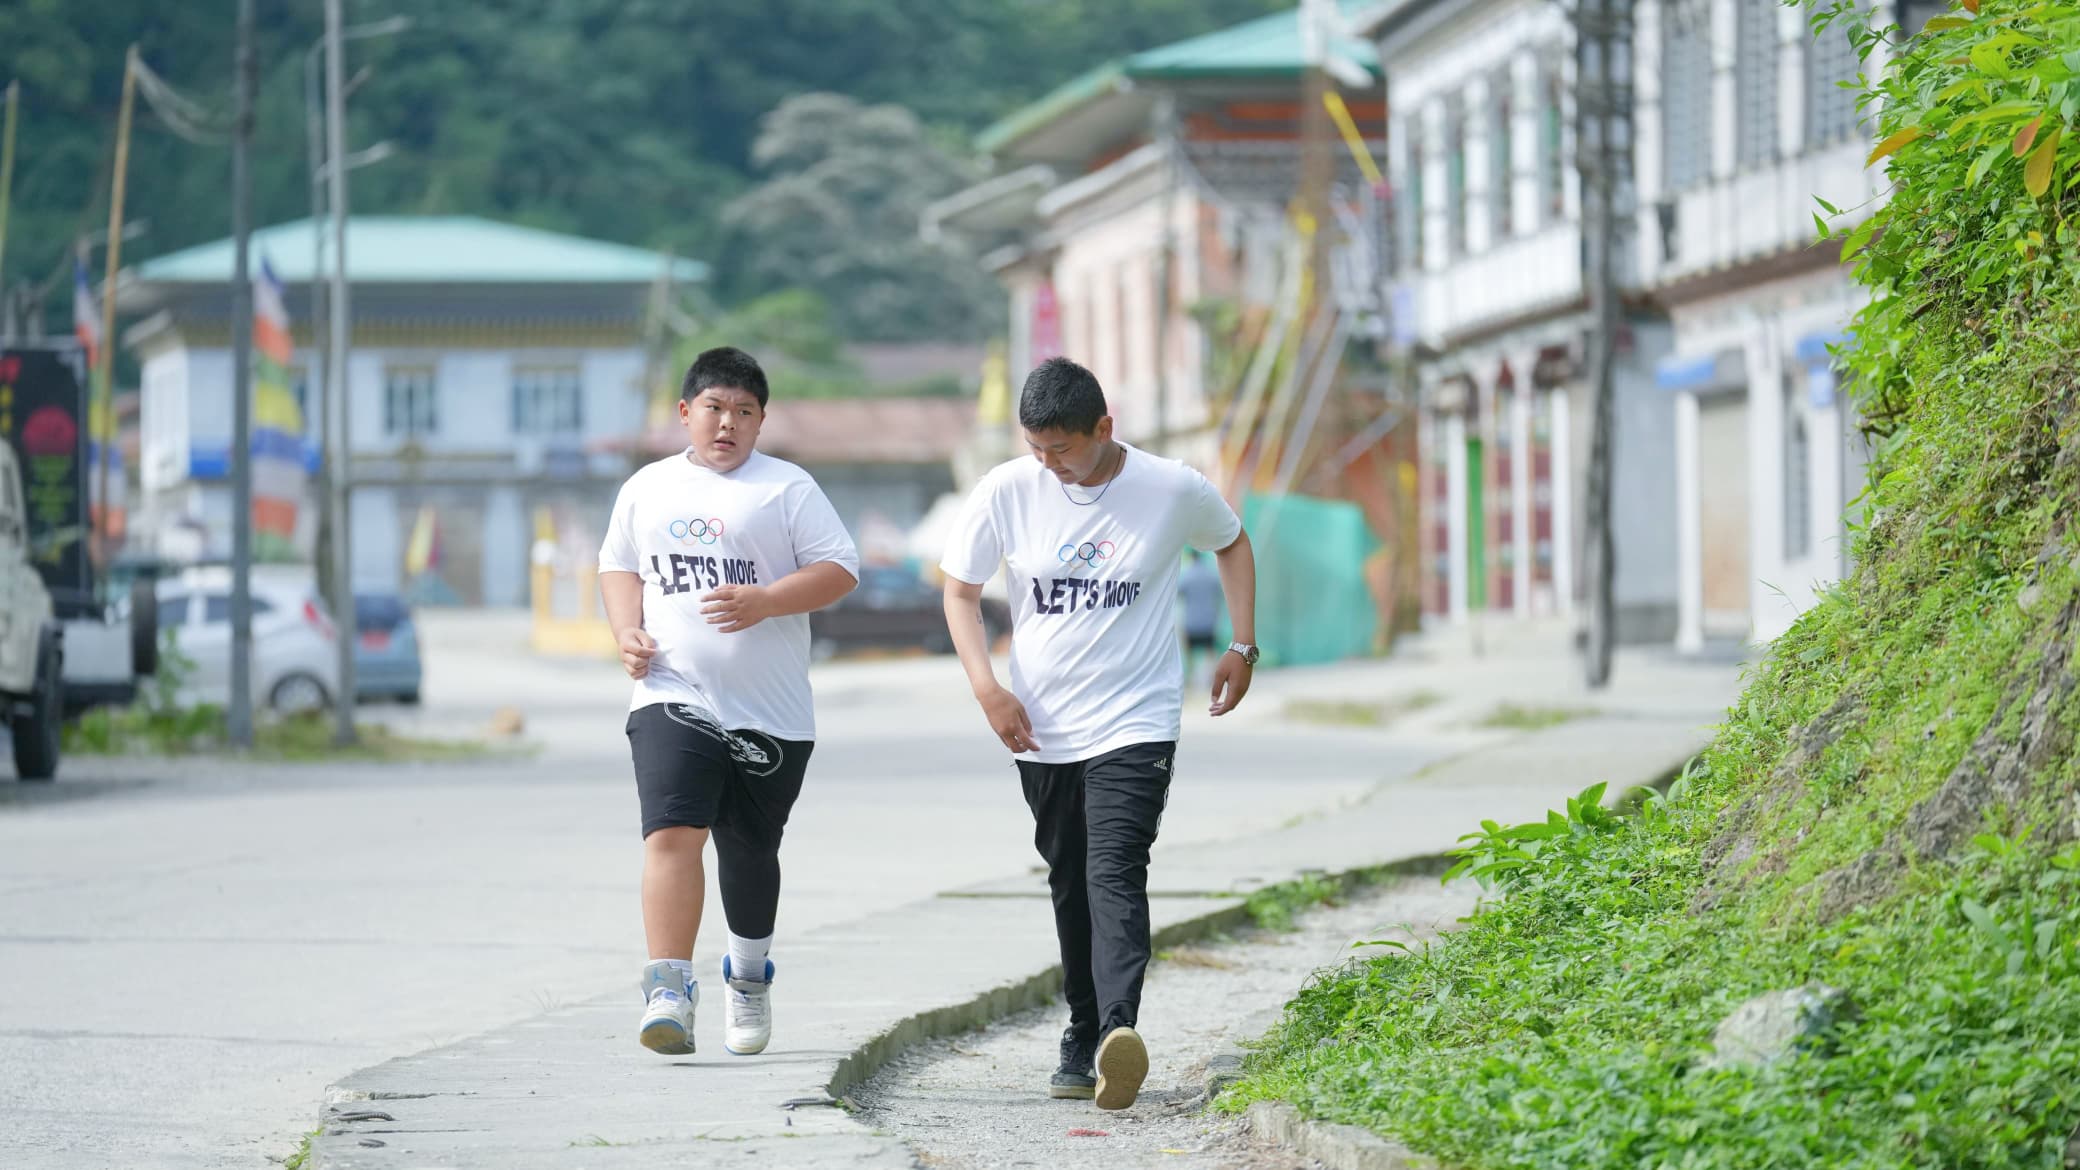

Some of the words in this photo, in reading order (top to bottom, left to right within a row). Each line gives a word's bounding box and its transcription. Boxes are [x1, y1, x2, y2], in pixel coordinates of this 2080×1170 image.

[650, 554, 719, 595] LET'S
[722, 558, 757, 584] MOVE
[1032, 577, 1099, 614] LET'S
